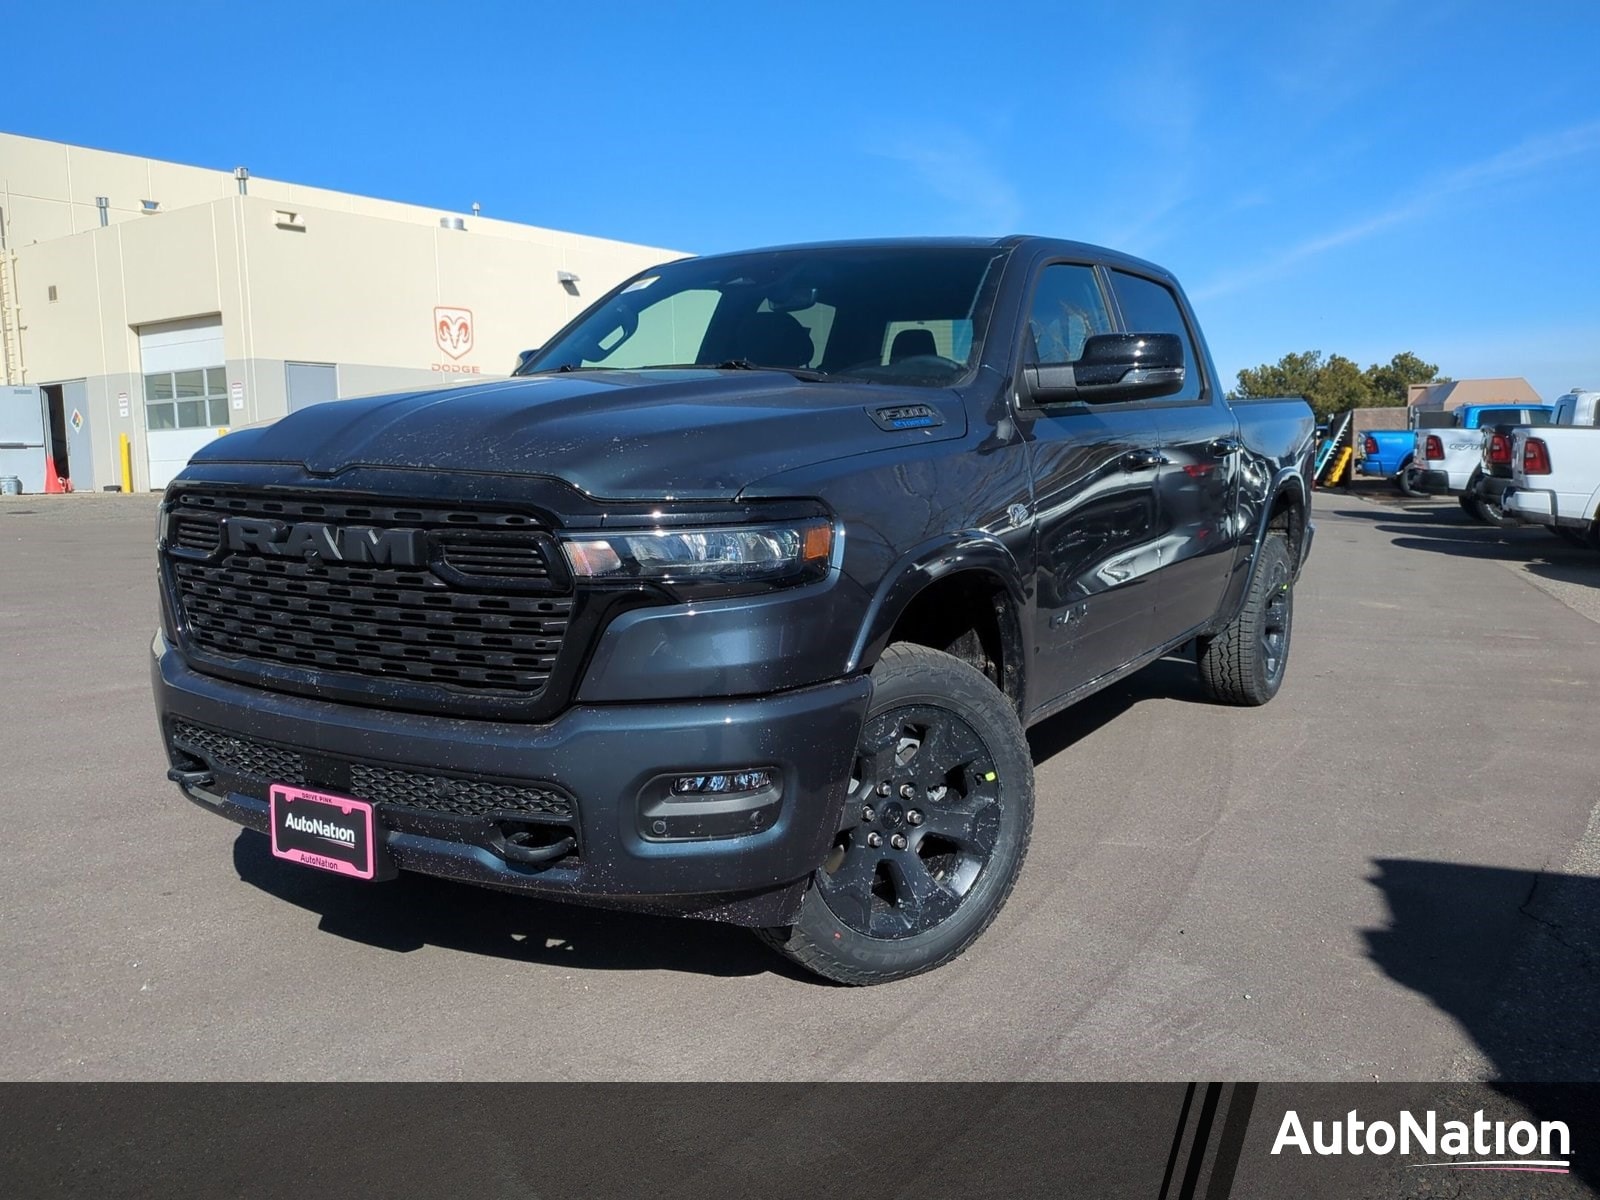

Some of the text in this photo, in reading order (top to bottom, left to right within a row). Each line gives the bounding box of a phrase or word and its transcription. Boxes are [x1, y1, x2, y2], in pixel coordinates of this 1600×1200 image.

[432, 363, 480, 374] DODGE
[227, 516, 426, 566] RAM
[301, 792, 318, 801] DRIVE
[284, 812, 355, 843] AutoNation
[300, 854, 338, 870] AutoNation
